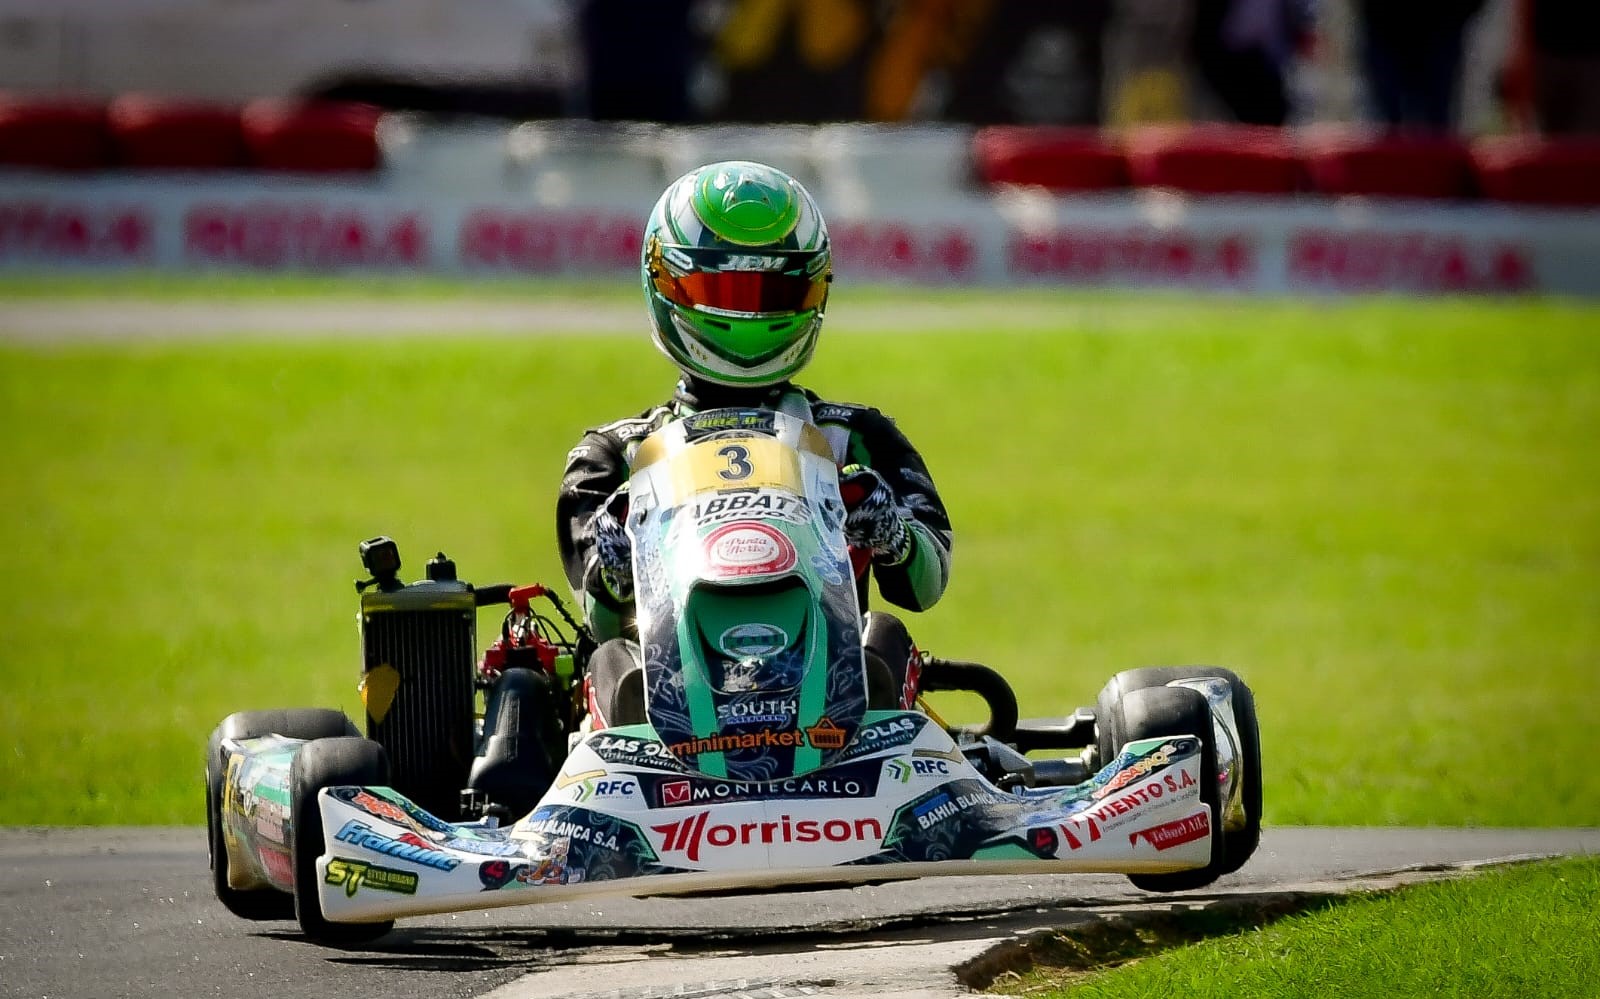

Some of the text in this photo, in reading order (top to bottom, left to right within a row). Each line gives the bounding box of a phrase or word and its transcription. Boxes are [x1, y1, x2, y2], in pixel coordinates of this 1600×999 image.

[718, 446, 754, 480] 3
[717, 700, 797, 719] SOUTH
[599, 736, 675, 759] LAS OL
[670, 728, 804, 759] minimarket
[911, 760, 950, 775] RFC
[595, 781, 636, 796] RFC
[693, 780, 860, 801] MONTECARLO
[1091, 782, 1164, 823] VIENTO
[1163, 768, 1197, 793] S.A.
[917, 800, 959, 830] BAHIA
[593, 831, 620, 851] S.A.
[650, 811, 882, 861] Morrison
[326, 860, 368, 897] ST
